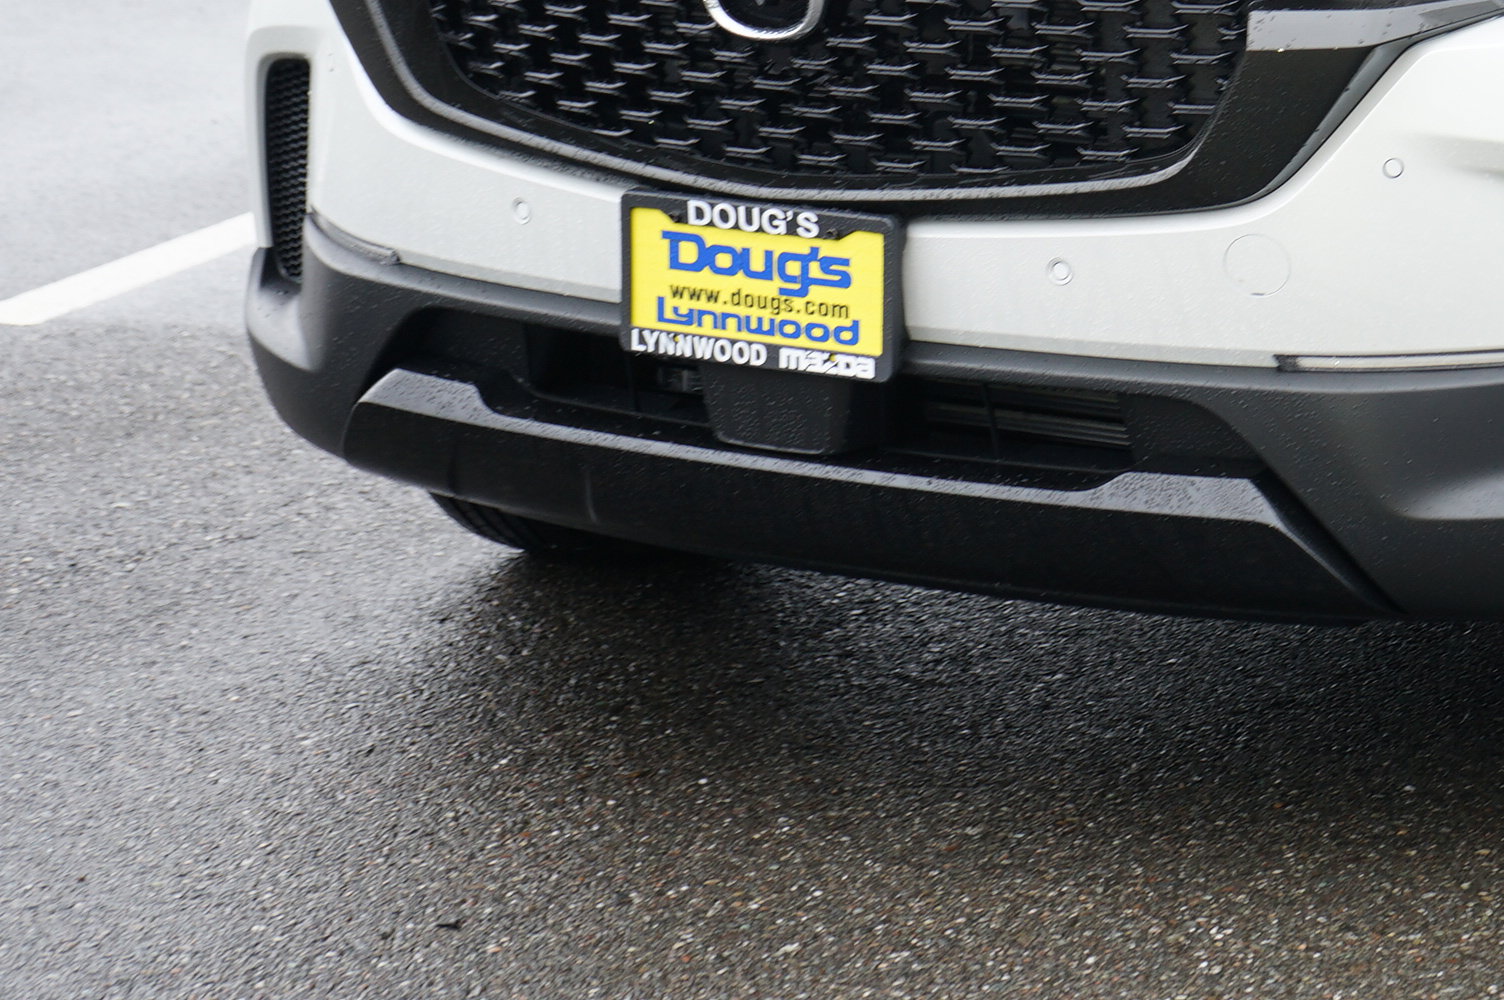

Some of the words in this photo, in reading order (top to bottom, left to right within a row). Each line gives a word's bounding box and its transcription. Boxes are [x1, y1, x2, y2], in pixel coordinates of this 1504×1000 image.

[687, 200, 820, 238] DOUG'S
[669, 284, 850, 319] www.dougs.com
[657, 296, 859, 346] Lynnwood
[631, 328, 767, 366] LYNNWOOD
